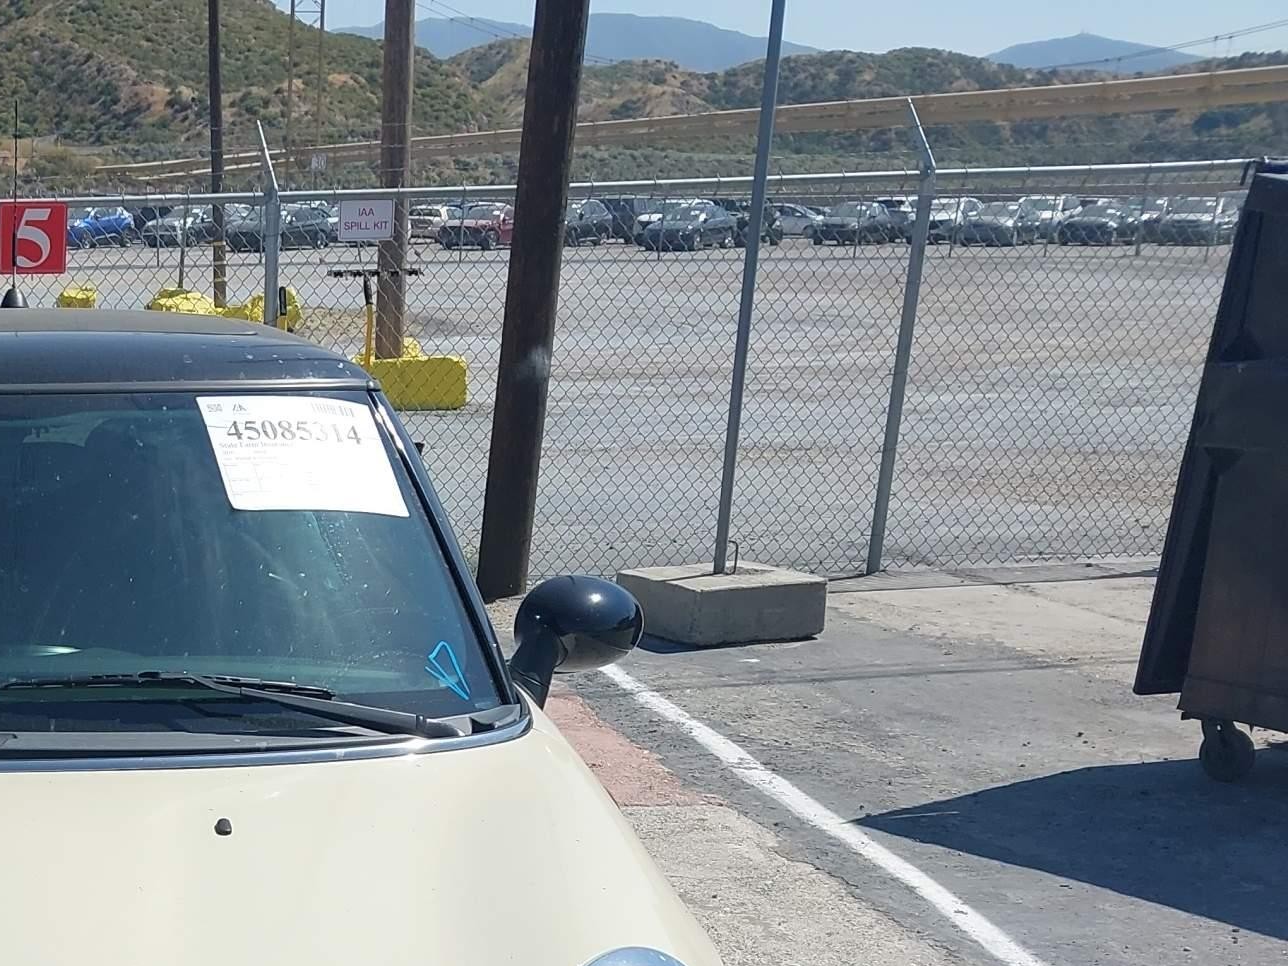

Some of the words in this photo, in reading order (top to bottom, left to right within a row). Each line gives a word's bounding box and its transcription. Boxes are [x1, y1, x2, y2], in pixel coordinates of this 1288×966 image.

[358, 208, 375, 217] IAA
[344, 221, 370, 231] SPILL
[373, 221, 389, 231] KIT
[14, 207, 52, 269] 5
[226, 419, 362, 445] 45085314
